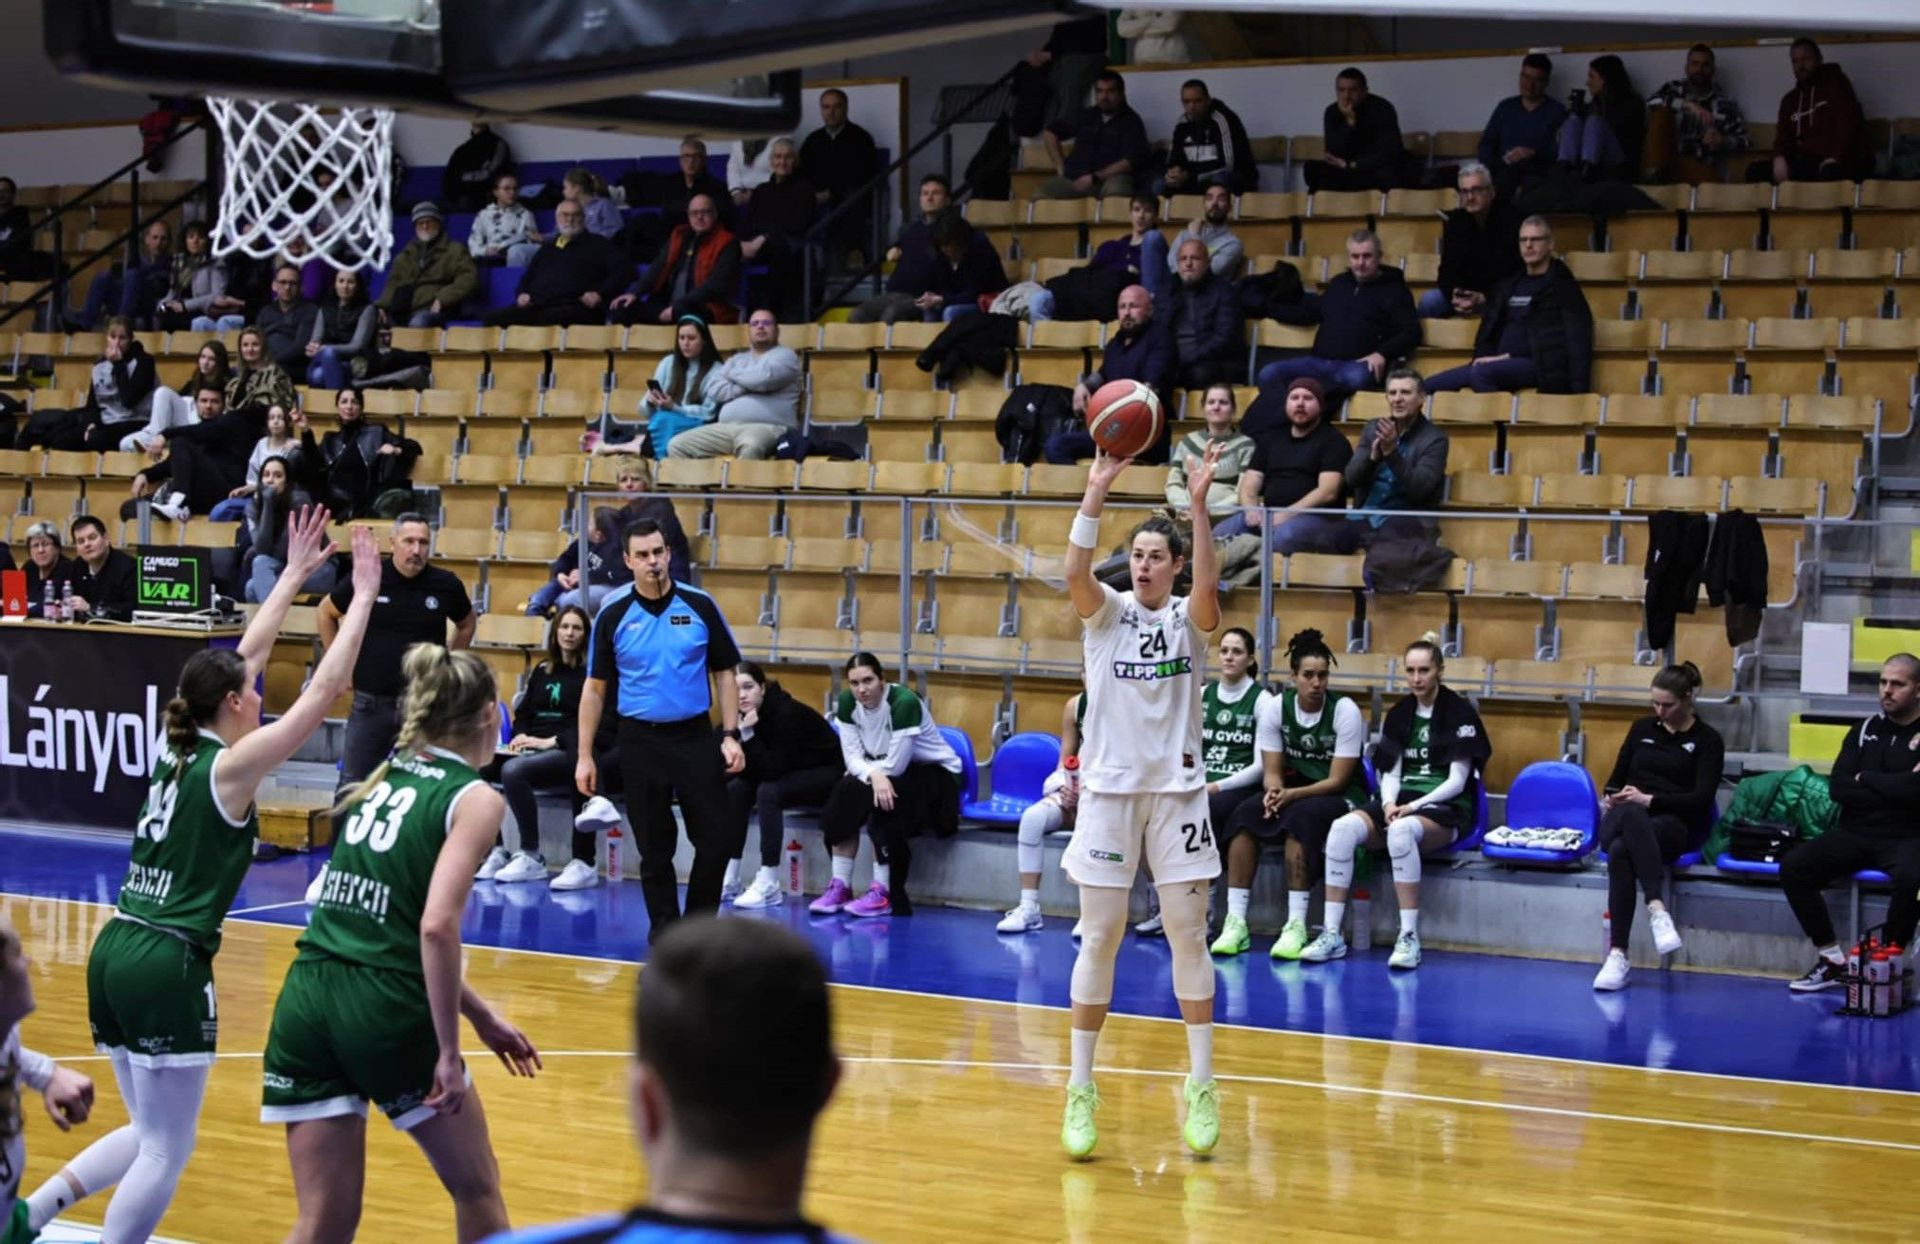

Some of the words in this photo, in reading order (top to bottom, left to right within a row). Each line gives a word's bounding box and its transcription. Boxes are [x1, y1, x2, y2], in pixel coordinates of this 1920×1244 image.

[143, 581, 190, 600] VAR
[1139, 629, 1168, 658] 24
[345, 781, 418, 853] 33
[1181, 818, 1213, 853] 24
